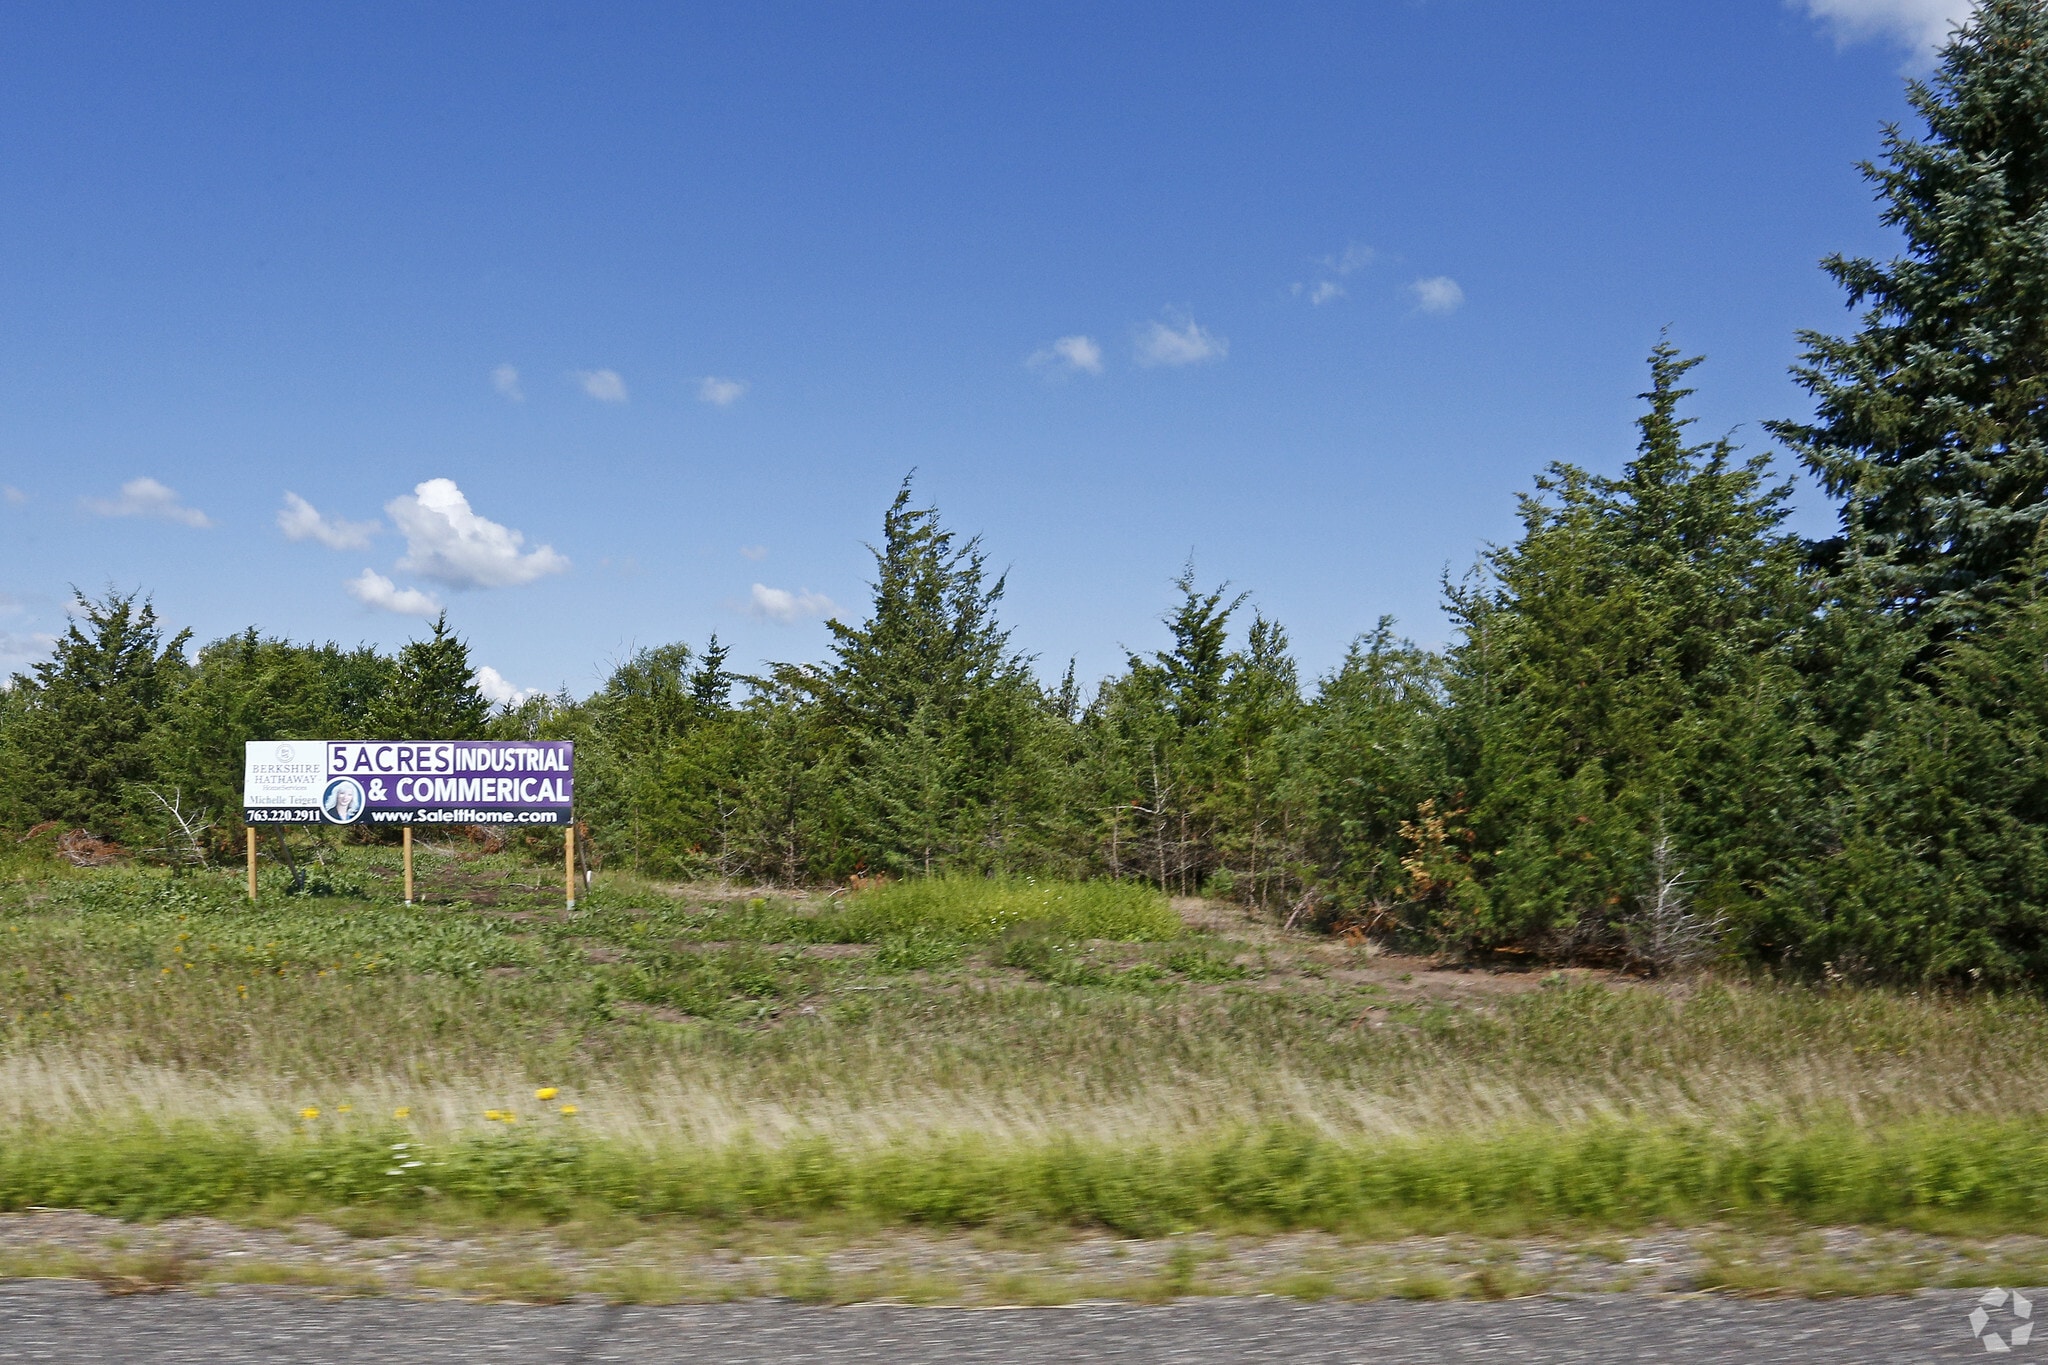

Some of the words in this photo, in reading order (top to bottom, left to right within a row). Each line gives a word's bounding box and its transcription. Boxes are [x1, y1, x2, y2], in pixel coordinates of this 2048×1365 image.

[333, 746, 347, 772] 5
[353, 746, 450, 772] ACRES
[455, 747, 570, 772] INDUSTRIAL
[252, 764, 321, 774] BERKSHIRE
[254, 775, 318, 784] HATHAWAY
[367, 777, 388, 801] &
[396, 777, 570, 802] COMMERICAL
[249, 795, 287, 805] Michelle
[289, 795, 318, 806] Teigen
[246, 809, 321, 822] 763.220.2911
